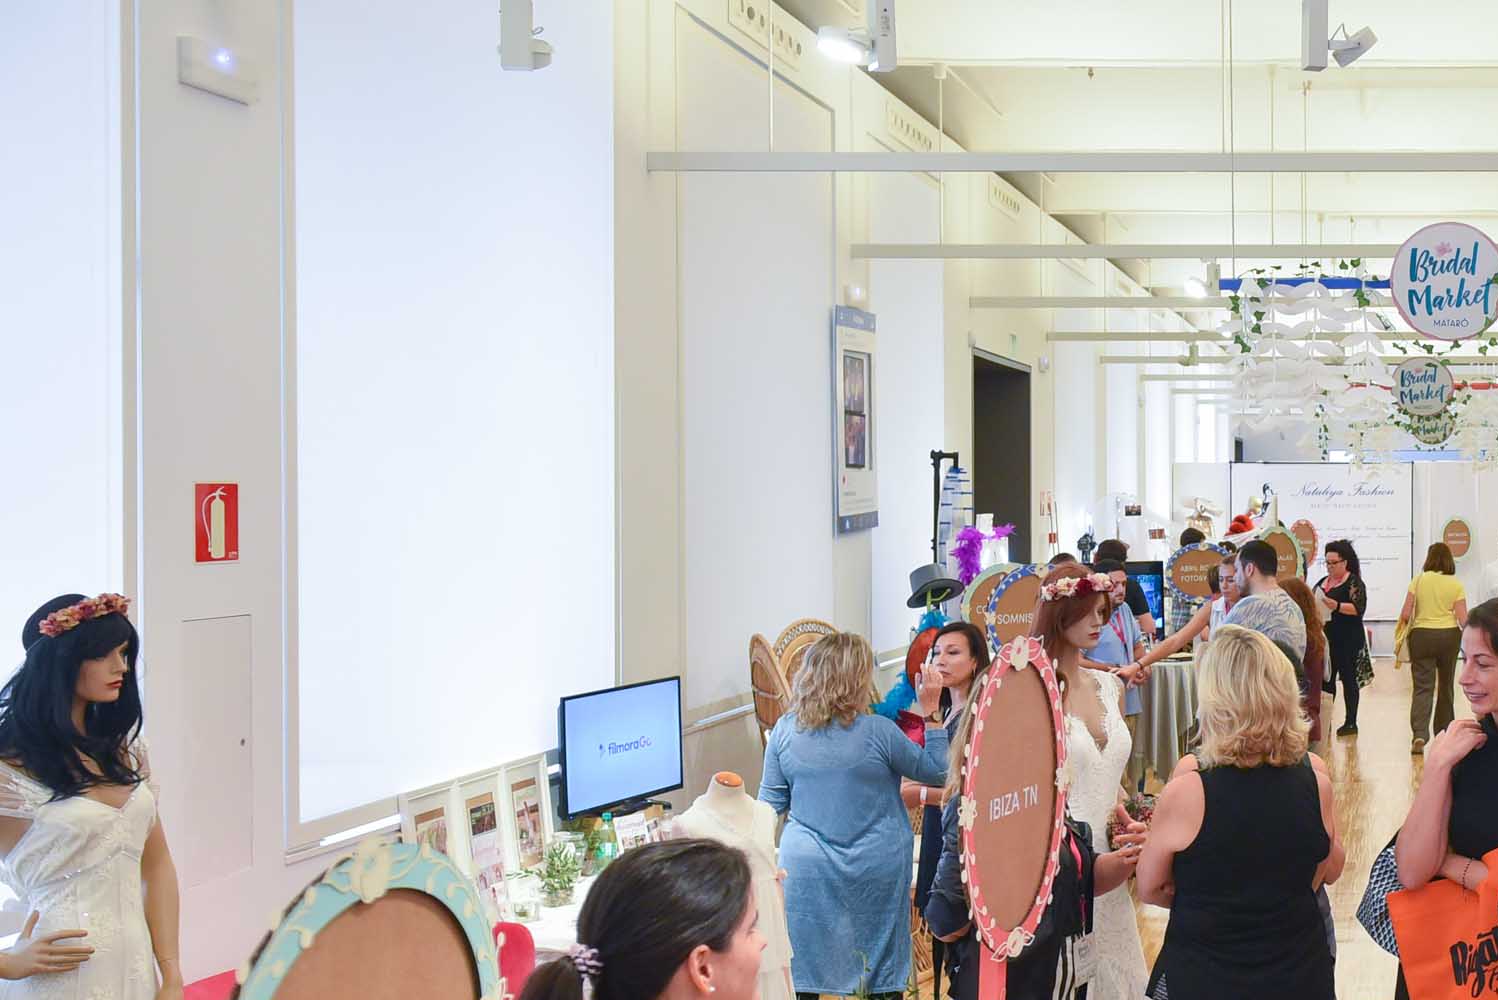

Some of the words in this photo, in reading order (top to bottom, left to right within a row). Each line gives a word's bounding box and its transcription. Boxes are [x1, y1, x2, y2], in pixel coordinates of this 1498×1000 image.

[1409, 241, 1479, 283] Bridal
[1407, 277, 1494, 316] Market
[1433, 317, 1469, 329] MATARÓ
[1400, 367, 1437, 388] Bridal
[1400, 385, 1448, 405] Market
[1350, 482, 1395, 497] Fashion
[989, 791, 1020, 823] IBIZA
[1023, 783, 1039, 808] TN
